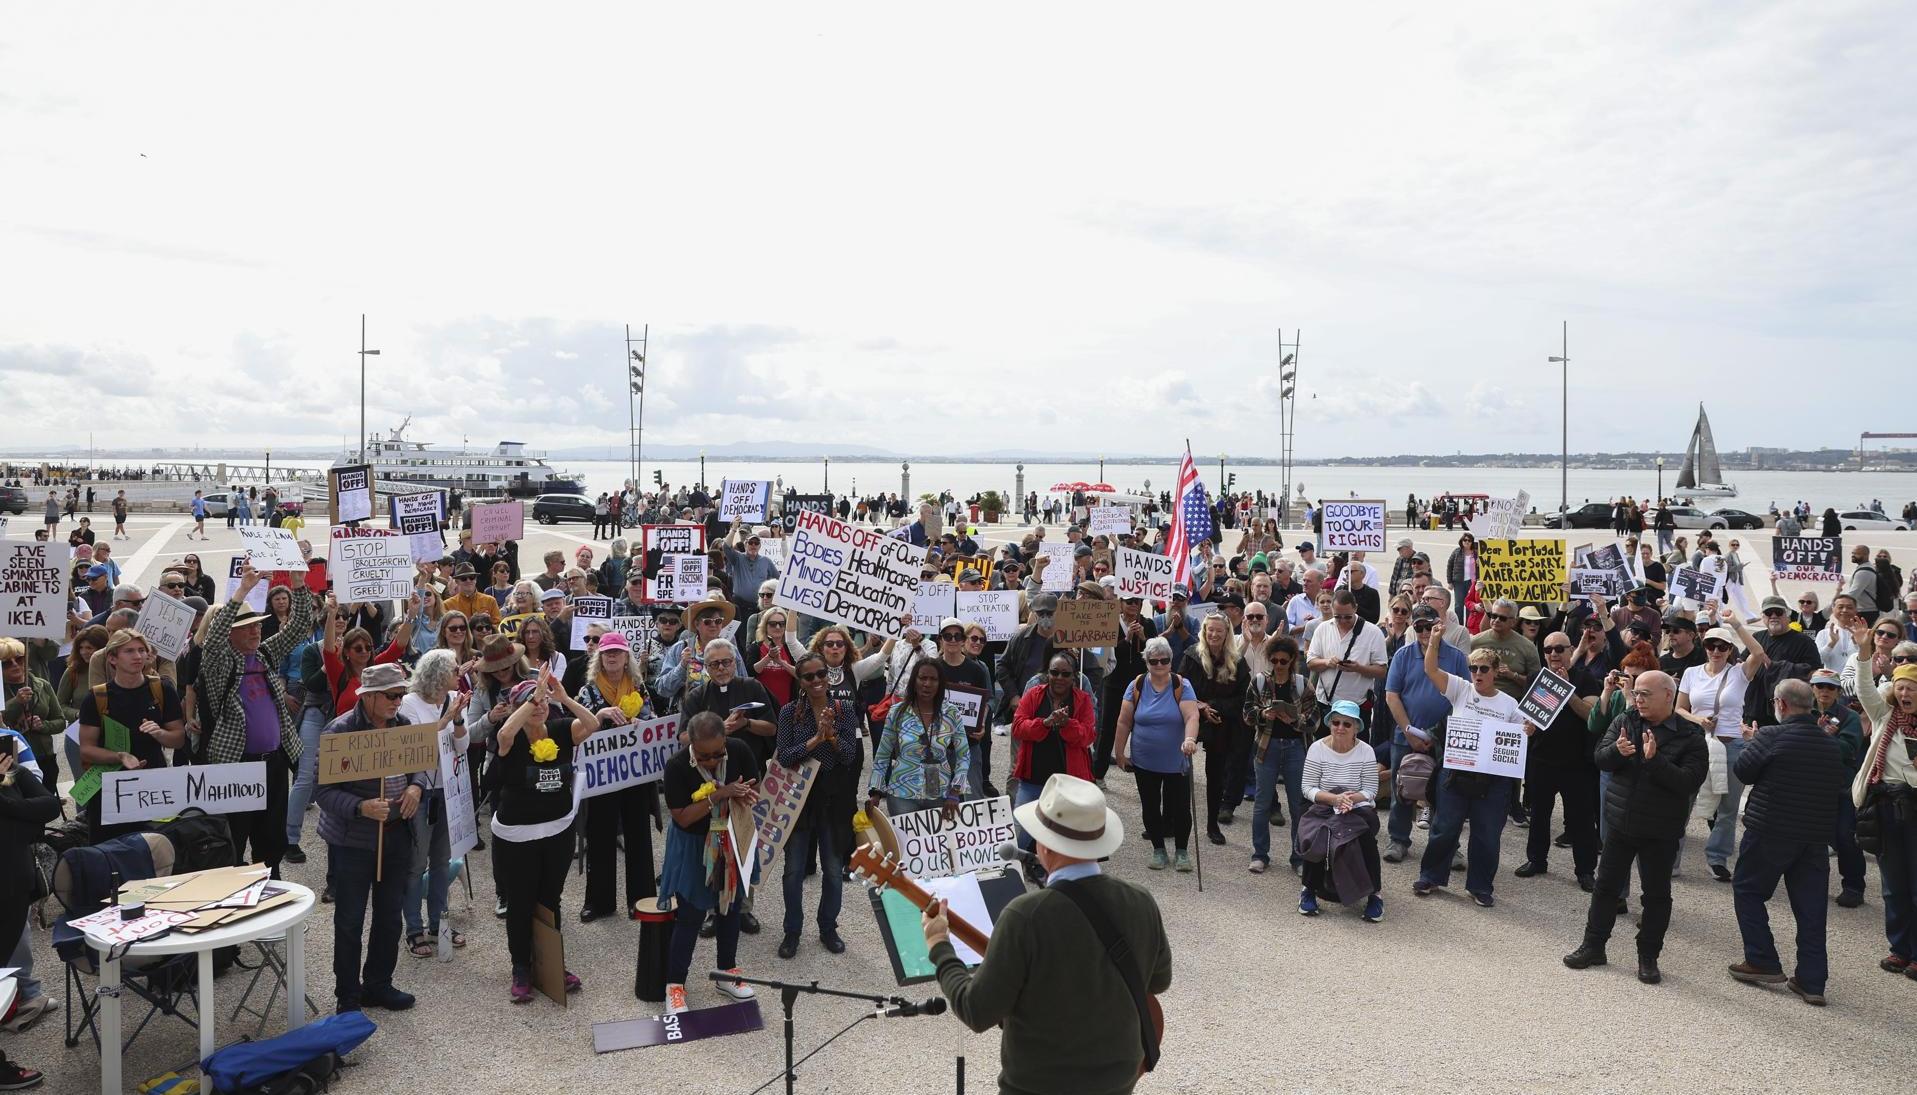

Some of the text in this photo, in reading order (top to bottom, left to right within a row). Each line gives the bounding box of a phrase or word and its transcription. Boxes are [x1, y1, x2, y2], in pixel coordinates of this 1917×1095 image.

[342, 472, 364, 481] HANDS
[343, 479, 364, 489] OFF!
[729, 482, 757, 494] HANDS
[398, 496, 419, 504] HANDS
[418, 500, 438, 508] MONEY
[404, 506, 437, 514] DEMOCRACY
[724, 504, 765, 515] DEMOCRACY
[786, 500, 828, 513] HANDS
[1326, 505, 1381, 519] GOODBYE
[404, 517, 431, 525] HANDS
[481, 515, 512, 524] CRIMINAL
[406, 524, 432, 533] OFF!
[798, 510, 852, 543] HANDS
[852, 529, 883, 552] OFF
[1325, 519, 1374, 532] TO OUR
[661, 529, 690, 538] HANDS
[661, 538, 690, 552] OFF!
[1329, 533, 1382, 548] RIGHTS
[1782, 538, 1834, 551] HANDS
[14, 546, 46, 557] I'VE
[344, 542, 384, 559] STOP
[1479, 540, 1502, 556] Dear
[1479, 556, 1496, 569] We
[1783, 550, 1828, 564] OFF!
[9, 558, 44, 569] SEEN
[356, 558, 409, 568] BROLIGARCHY
[1124, 553, 1173, 575] HANDS
[2, 568, 60, 581] SMARTER
[352, 569, 391, 579] CRUELTY
[679, 574, 704, 584] FASCISMO
[1134, 571, 1149, 581] ON
[1780, 572, 1841, 582] DEMOCRACY
[658, 575, 674, 589] FR
[354, 586, 384, 596] GREED
[1120, 577, 1173, 599] JUSTICE!
[1523, 583, 1564, 602] AGHAST
[657, 590, 673, 599] SPE
[979, 594, 1000, 604] STOP
[16, 596, 37, 607] AT
[579, 600, 606, 608] HANDS
[1061, 601, 1116, 612] IT'S TIME TO
[158, 600, 177, 623] YES
[579, 607, 606, 616] OFF!
[967, 605, 981, 613] DICK
[983, 604, 1010, 613] TRATOR
[8, 611, 46, 626] IKEA
[910, 615, 949, 627] HEALT
[973, 616, 993, 625] SAVE
[1071, 612, 1092, 620] TAKE
[143, 618, 159, 640] FREE
[614, 619, 646, 630] HANDS
[1054, 629, 1117, 644] OLIGARBAGE
[1540, 675, 1568, 697] WE ARE
[1524, 700, 1550, 722] NOT OK
[584, 721, 676, 757] HANDS OFF
[1451, 730, 1478, 740] HANDS
[1495, 731, 1522, 739] HANDS
[325, 738, 339, 753] I
[349, 732, 389, 749] RESIST
[1450, 737, 1477, 750] OFF!
[1495, 737, 1521, 748] OFF!
[1493, 747, 1520, 757] SEGURO
[329, 754, 369, 776] LOVE
[372, 750, 396, 770] FIRE
[404, 746, 434, 767] FAITH
[1492, 754, 1519, 765] SOCIAL
[116, 772, 265, 813] FREE MAHMOUD
[757, 762, 813, 866] JUSTICE
[906, 824, 1015, 857] OUR BODIES
[910, 853, 950, 875] OUR
[960, 844, 1001, 867] MONE
[663, 1014, 683, 1041] BAS
